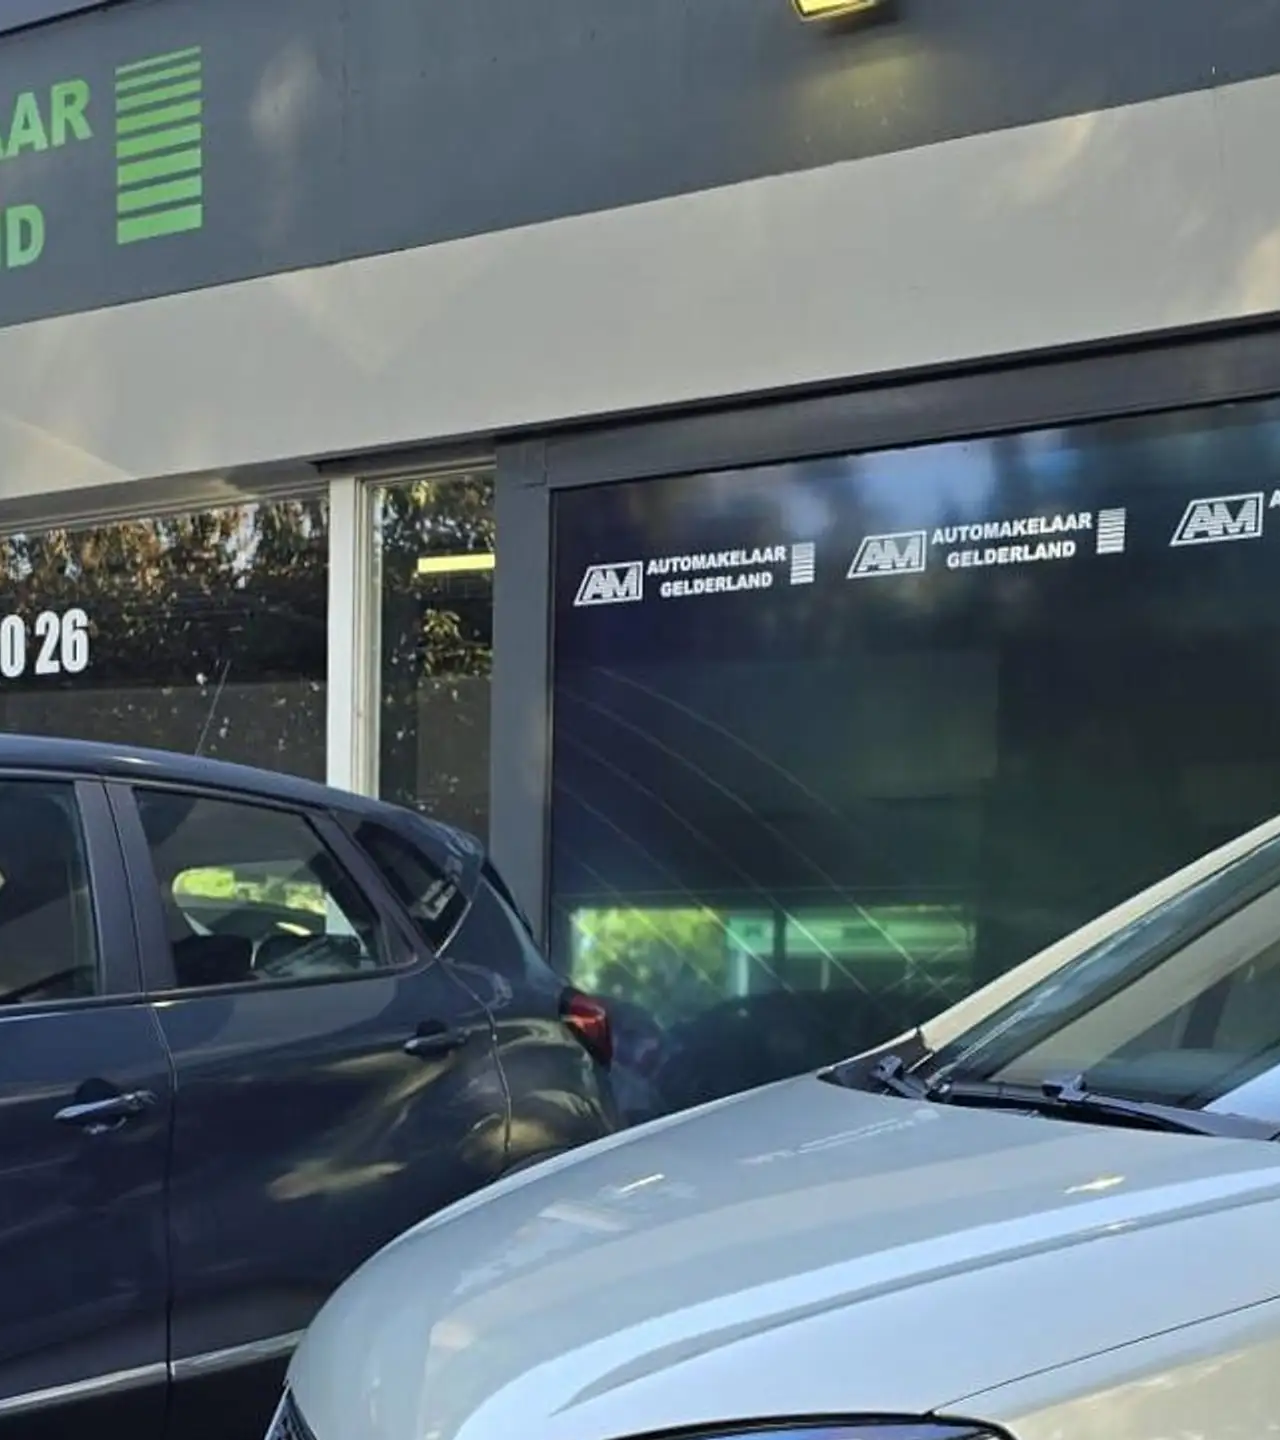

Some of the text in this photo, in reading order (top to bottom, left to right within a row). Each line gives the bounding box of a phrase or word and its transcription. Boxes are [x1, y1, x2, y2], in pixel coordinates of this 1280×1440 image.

[932, 512, 1092, 545] AUTOMAKELAAR
[1182, 499, 1257, 536] AM
[648, 546, 785, 575] AUTOMAKELAAR
[858, 537, 920, 572] AM
[947, 540, 1075, 568] GELDERLAND
[583, 567, 638, 600] AM
[661, 572, 772, 597] GELDERLAND
[36, 609, 89, 674] 26
